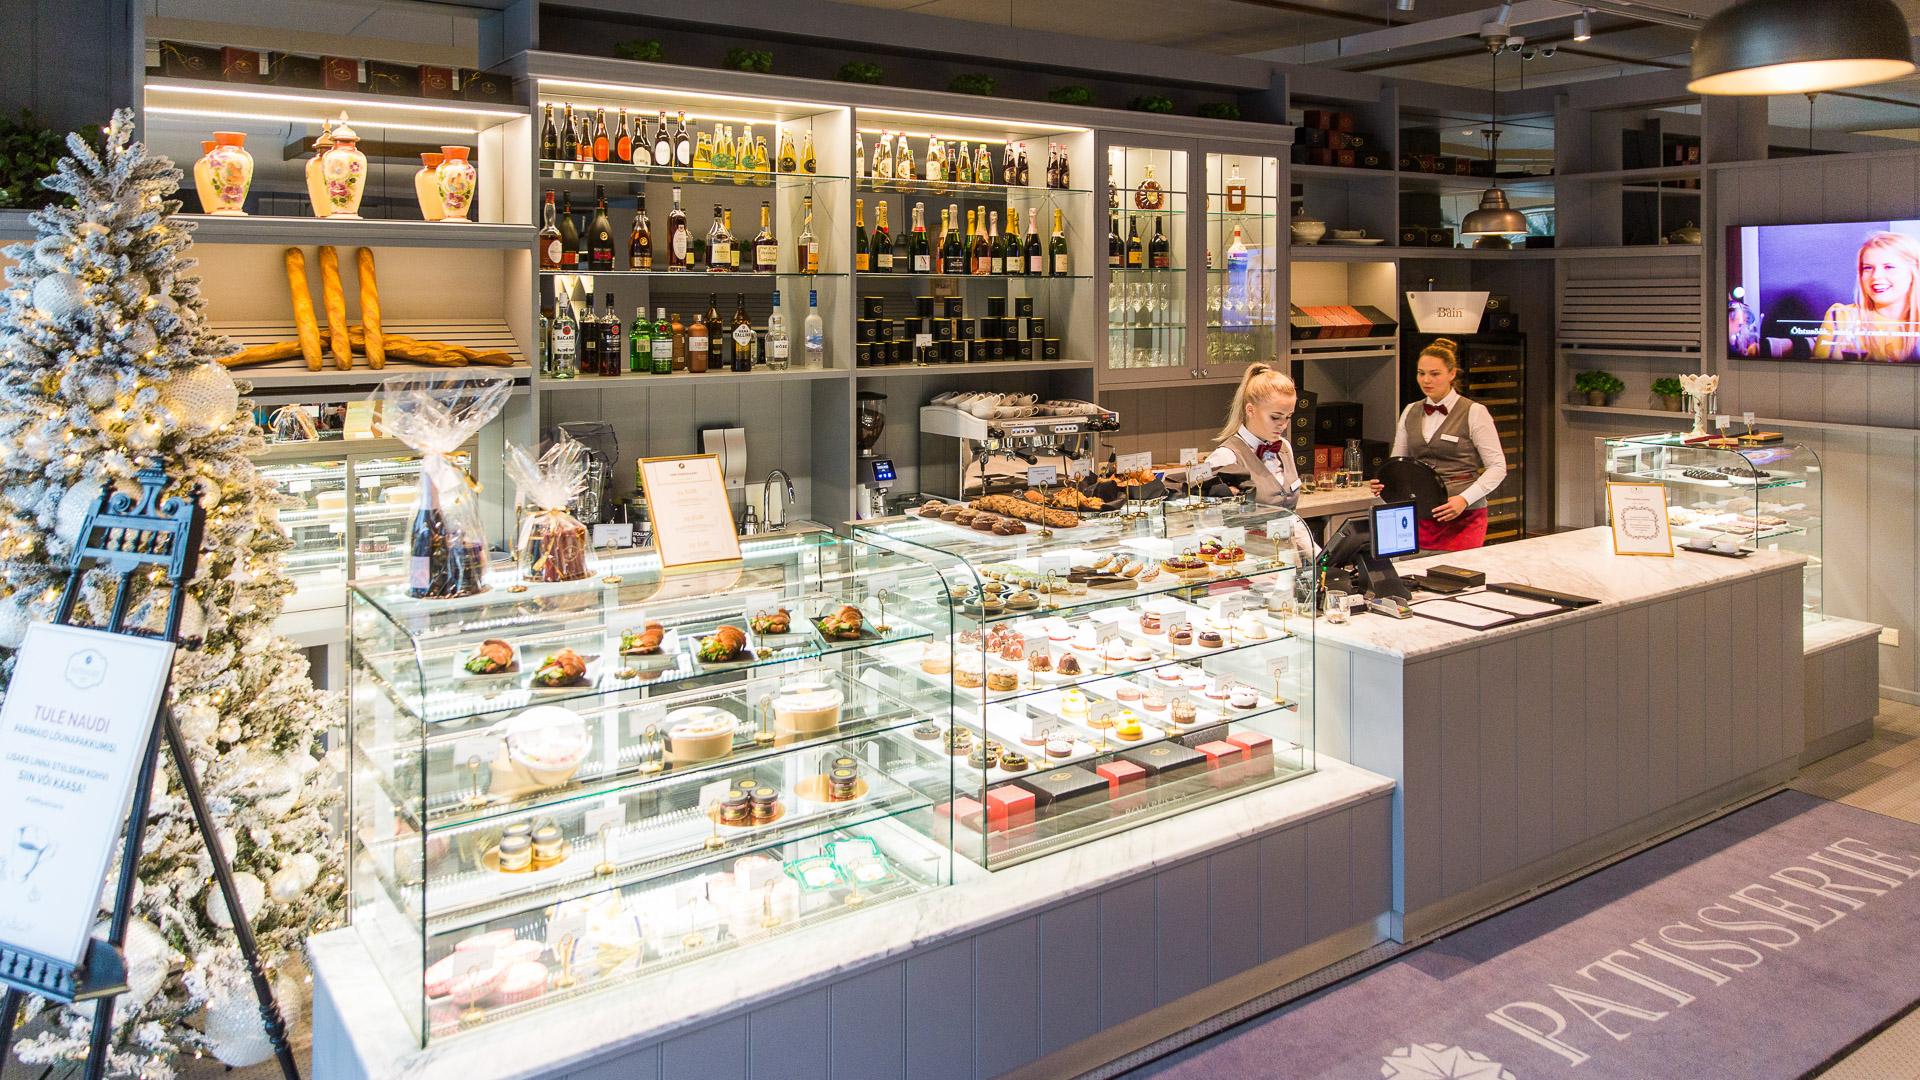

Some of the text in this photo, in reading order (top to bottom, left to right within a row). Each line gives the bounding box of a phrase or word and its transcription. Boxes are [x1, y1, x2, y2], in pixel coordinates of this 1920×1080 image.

[35, 704, 111, 733] TULE NAUDI
[18, 769, 36, 783] SIIN
[1485, 837, 1920, 1067] PATISSERIE
